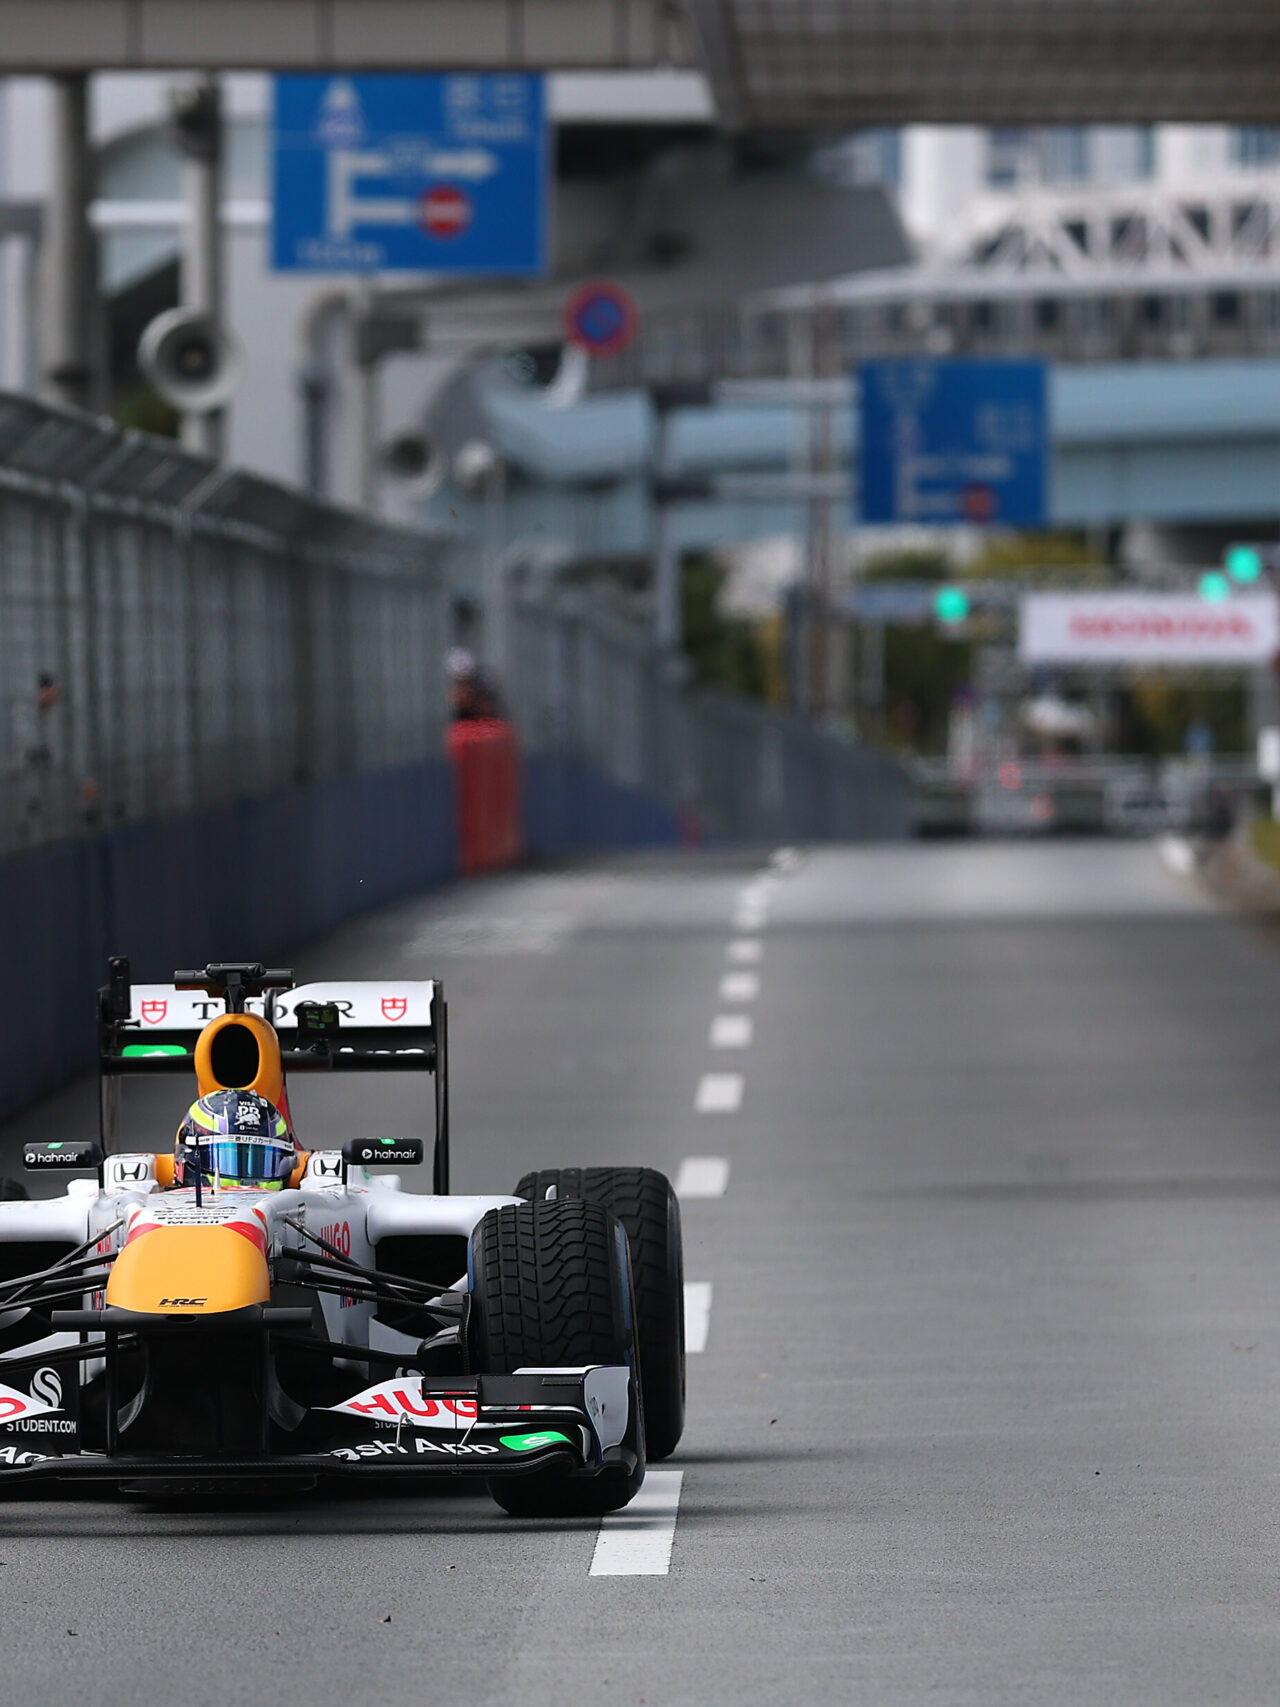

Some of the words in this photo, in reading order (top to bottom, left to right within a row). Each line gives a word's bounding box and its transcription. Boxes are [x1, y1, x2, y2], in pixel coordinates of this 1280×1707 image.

[37, 1152, 78, 1163] hahnair
[374, 1149, 416, 1159] hahnair
[159, 1298, 208, 1306] HRC
[6, 1419, 77, 1434] STUDENT.COM
[415, 1438, 500, 1456] App
